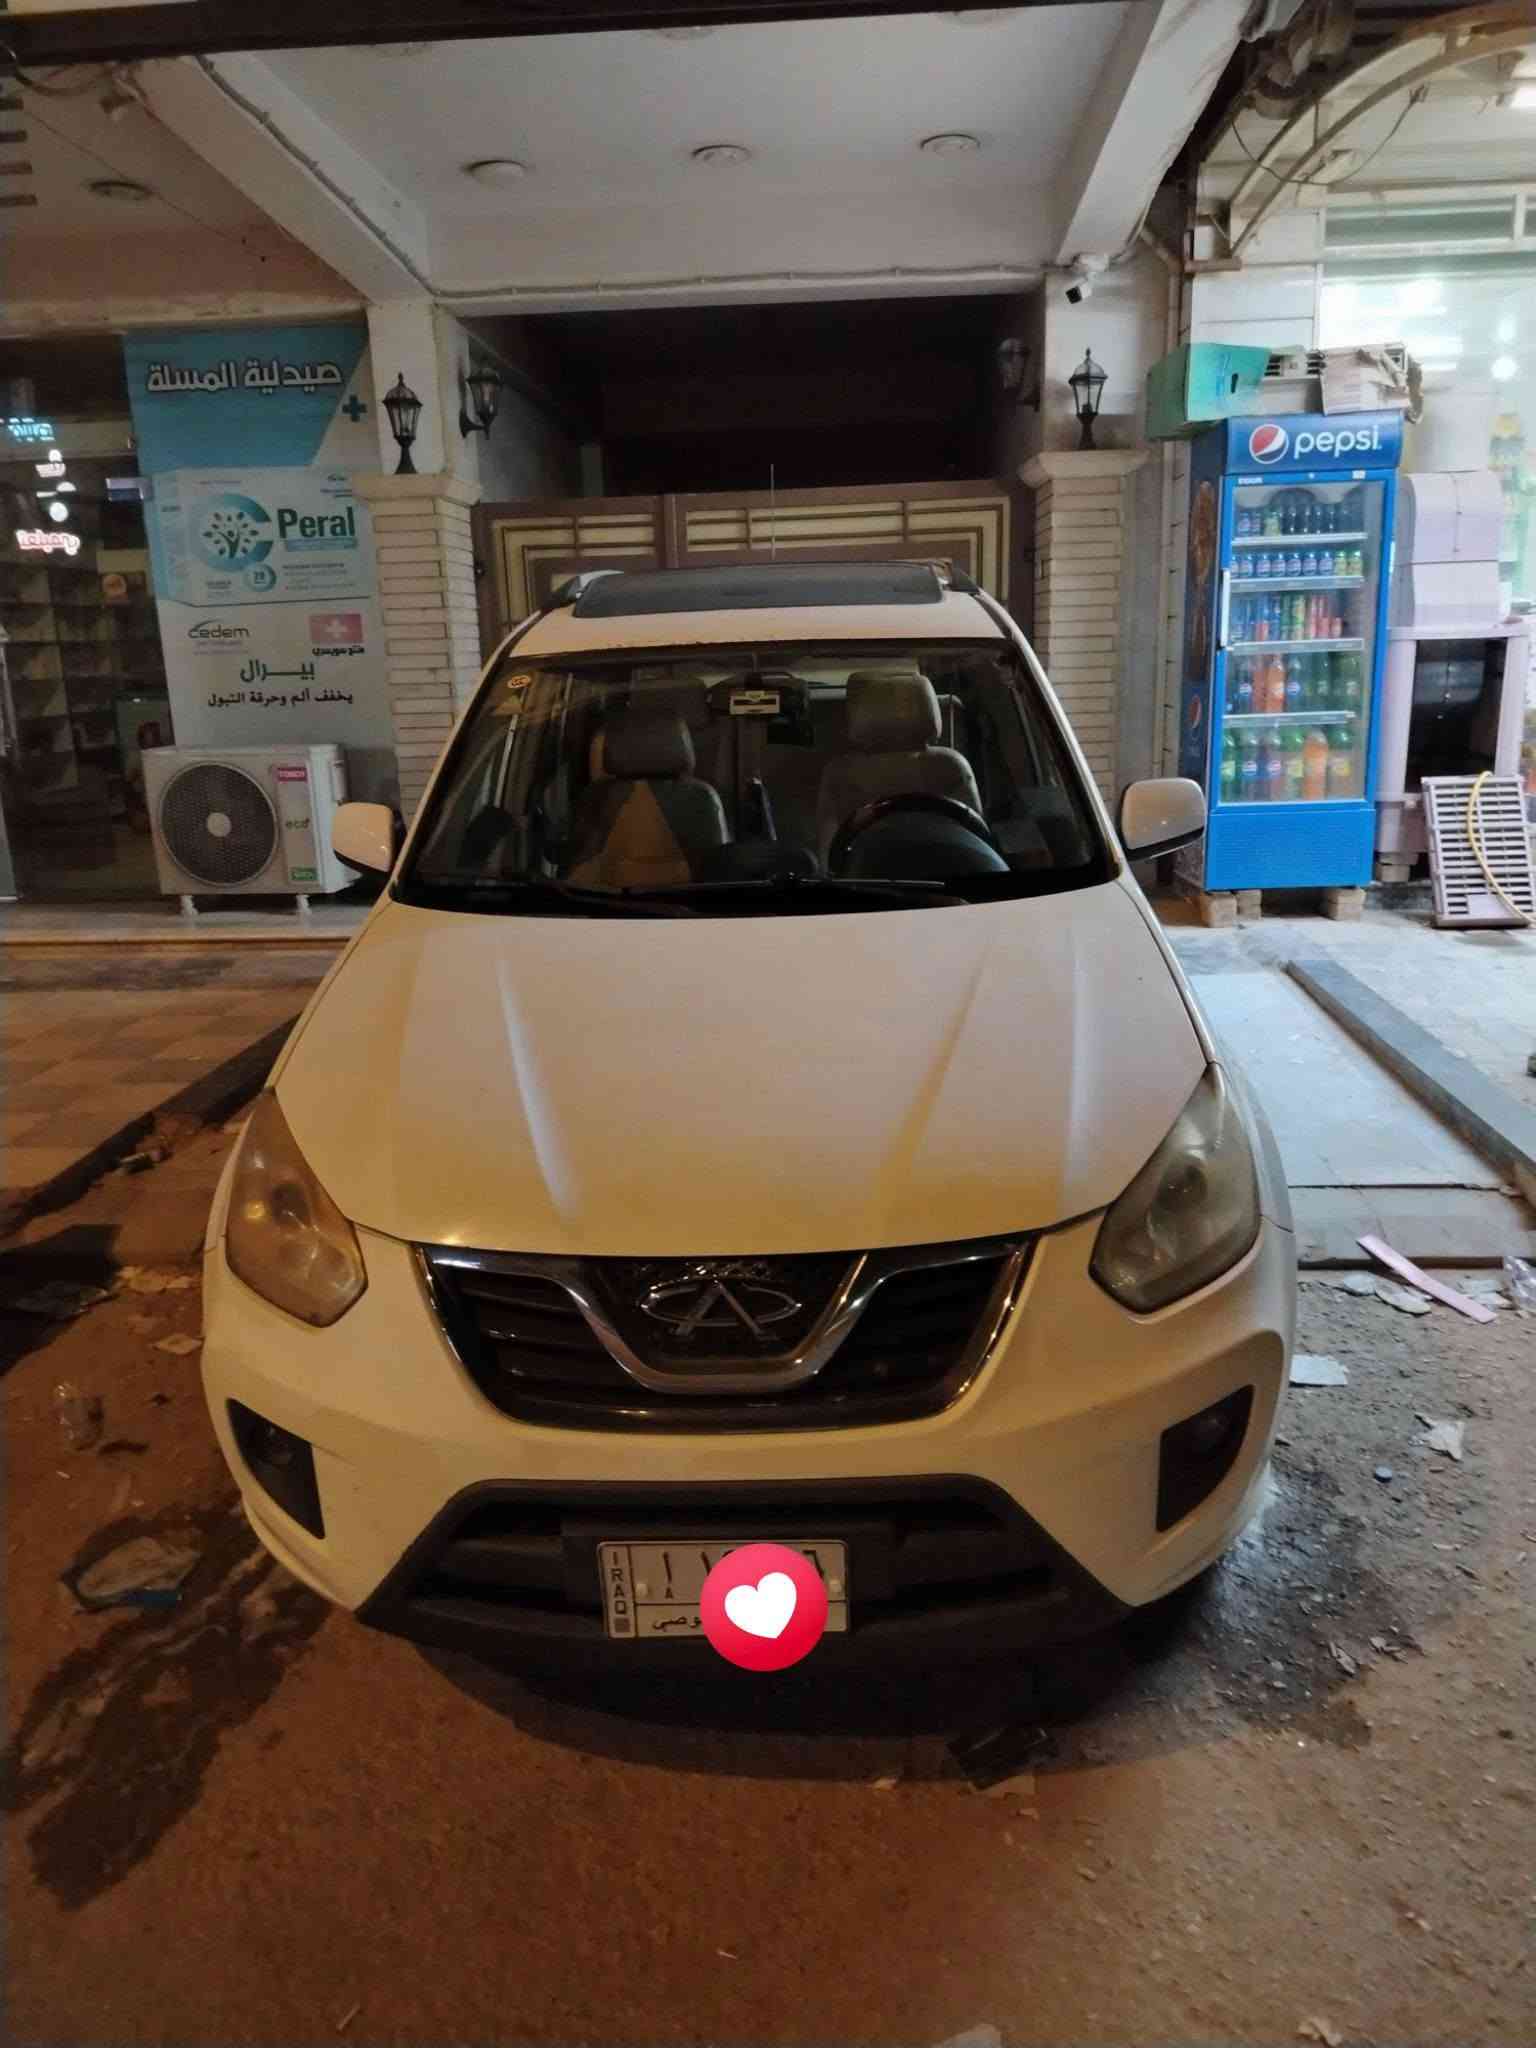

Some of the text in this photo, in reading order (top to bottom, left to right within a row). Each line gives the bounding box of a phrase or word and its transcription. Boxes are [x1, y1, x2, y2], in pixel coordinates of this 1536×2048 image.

[148, 359, 342, 394] صيدلية المسلة
[1293, 425, 1380, 460] pepsi
[277, 507, 356, 538] Peral
[188, 621, 250, 638] cedem
[314, 688, 353, 704] يخفف
